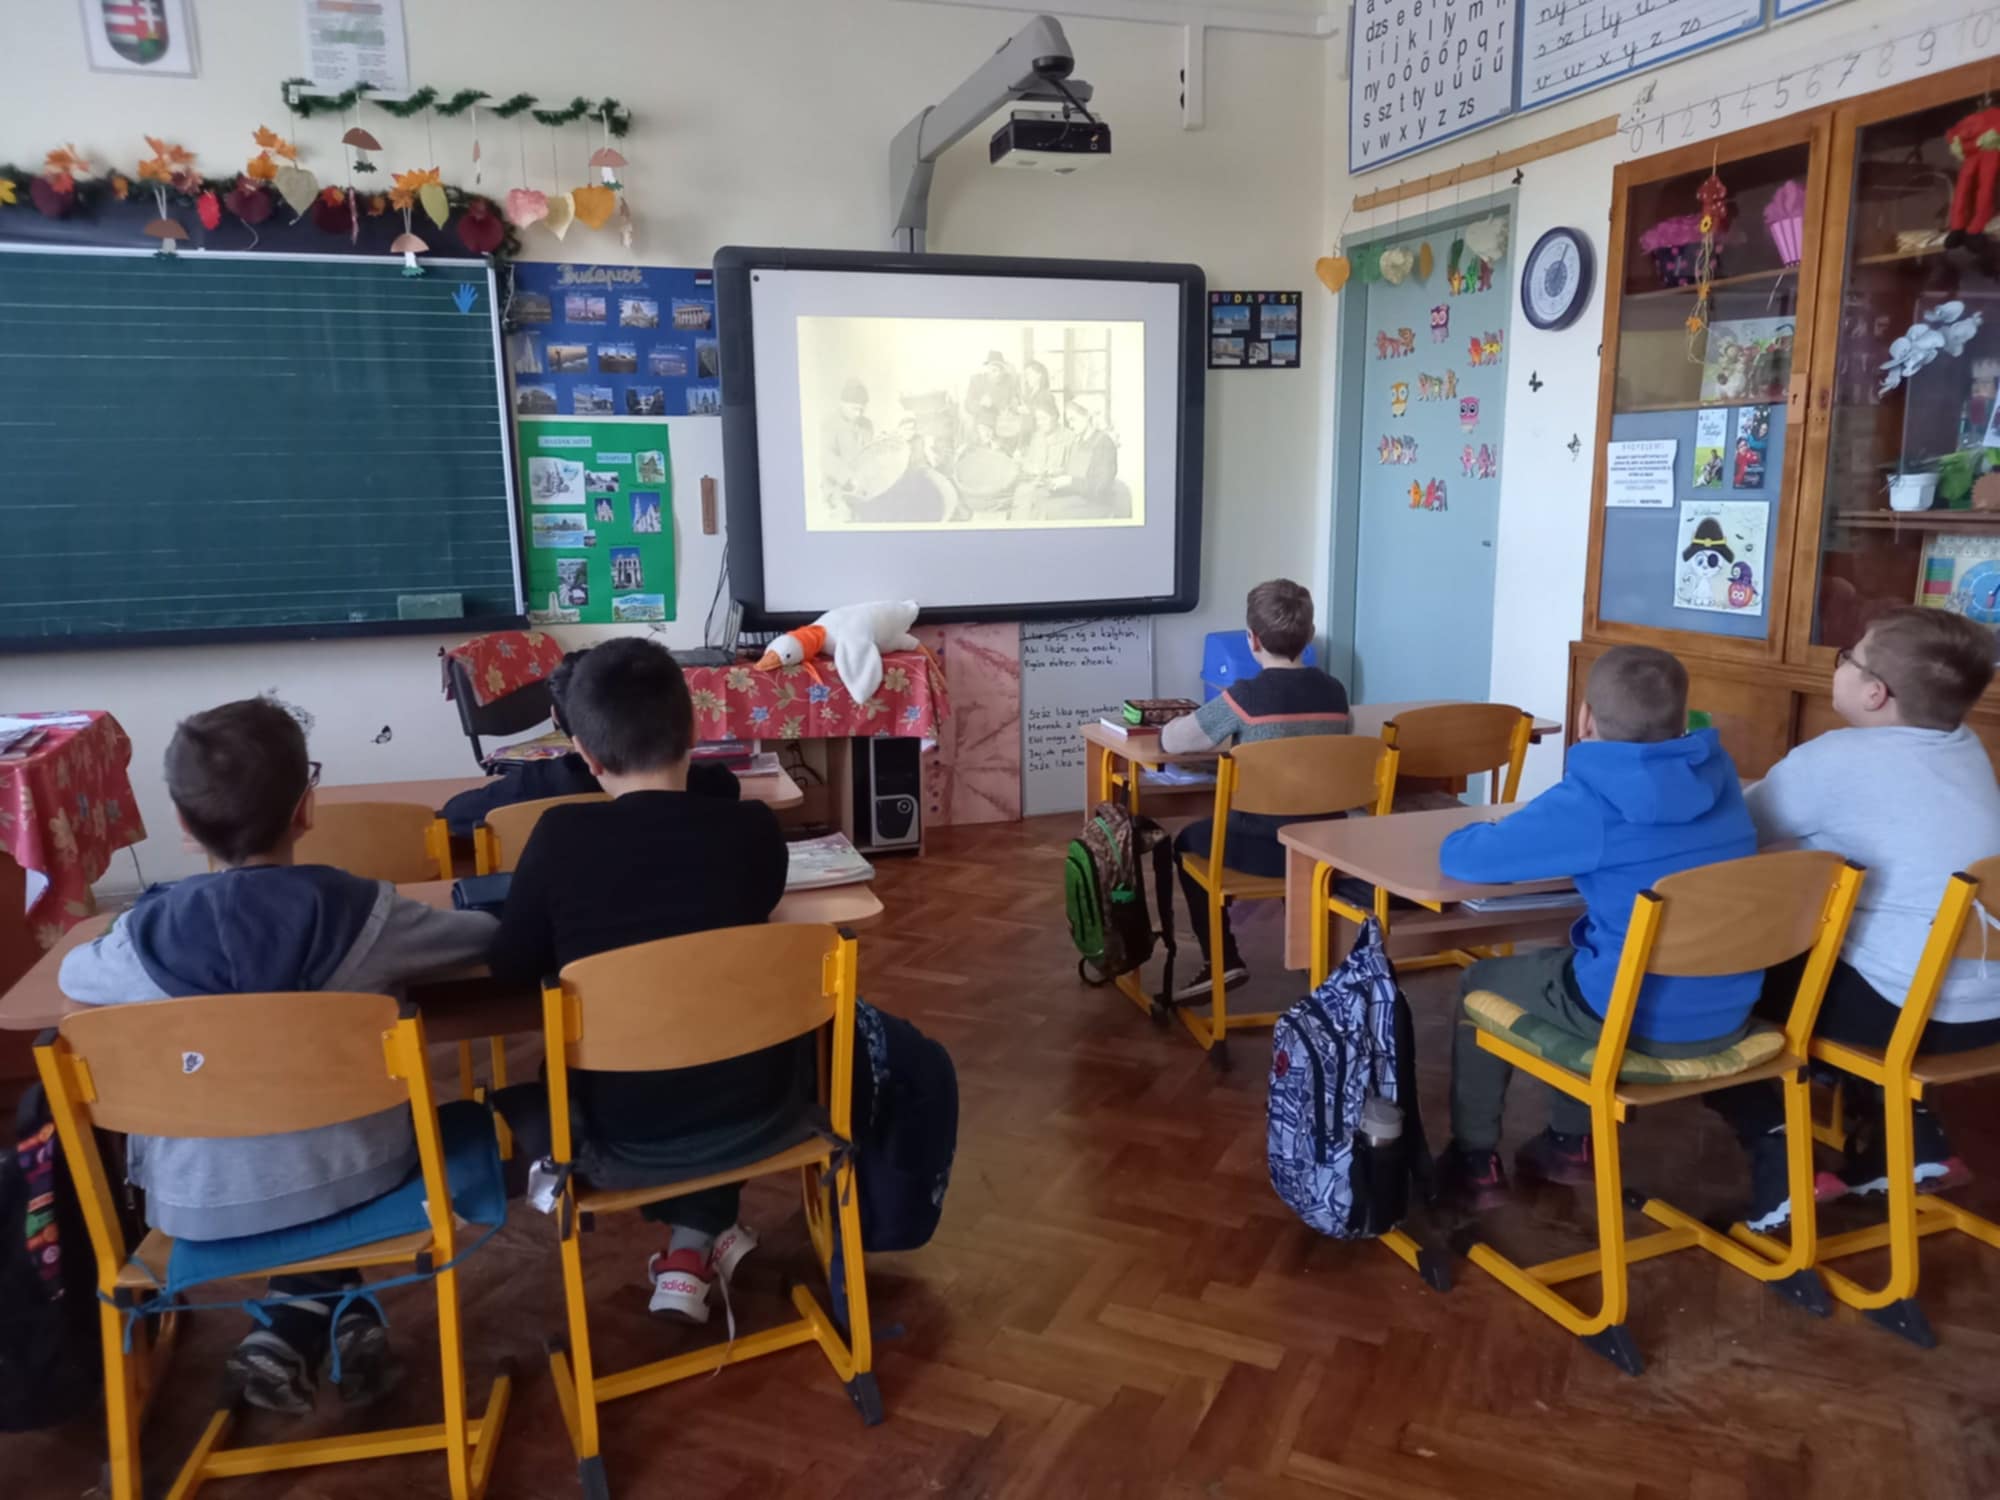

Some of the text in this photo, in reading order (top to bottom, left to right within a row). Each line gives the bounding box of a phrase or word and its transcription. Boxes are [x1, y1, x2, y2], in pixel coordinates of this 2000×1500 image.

[1366, 19, 1389, 42] dzs
[1397, 9, 1405, 26] e
[1408, 29, 1417, 50] k
[1444, 11, 1456, 38] ly
[1469, 1, 1483, 22] m
[1364, 80, 1380, 103] ny
[1388, 72, 1396, 89] o
[1457, 38, 1467, 63] p
[1478, 29, 1488, 52] q
[1499, 20, 1505, 40] r
[1597, 50, 1613, 68] x
[1363, 112, 1371, 128] s
[1378, 102, 1392, 122] sz
[1400, 92, 1405, 113] t
[1412, 86, 1426, 111] ty
[1435, 80, 1444, 97] u
[1655, 113, 1665, 145] 1
[1709, 99, 1721, 129] 3
[1774, 75, 1795, 109] 5
[1804, 65, 1822, 98] 6
[1837, 53, 1861, 88] 7
[1876, 42, 1895, 78] 8
[1916, 28, 1936, 66] 9
[1362, 97, 1475, 156] v w x y z zs
